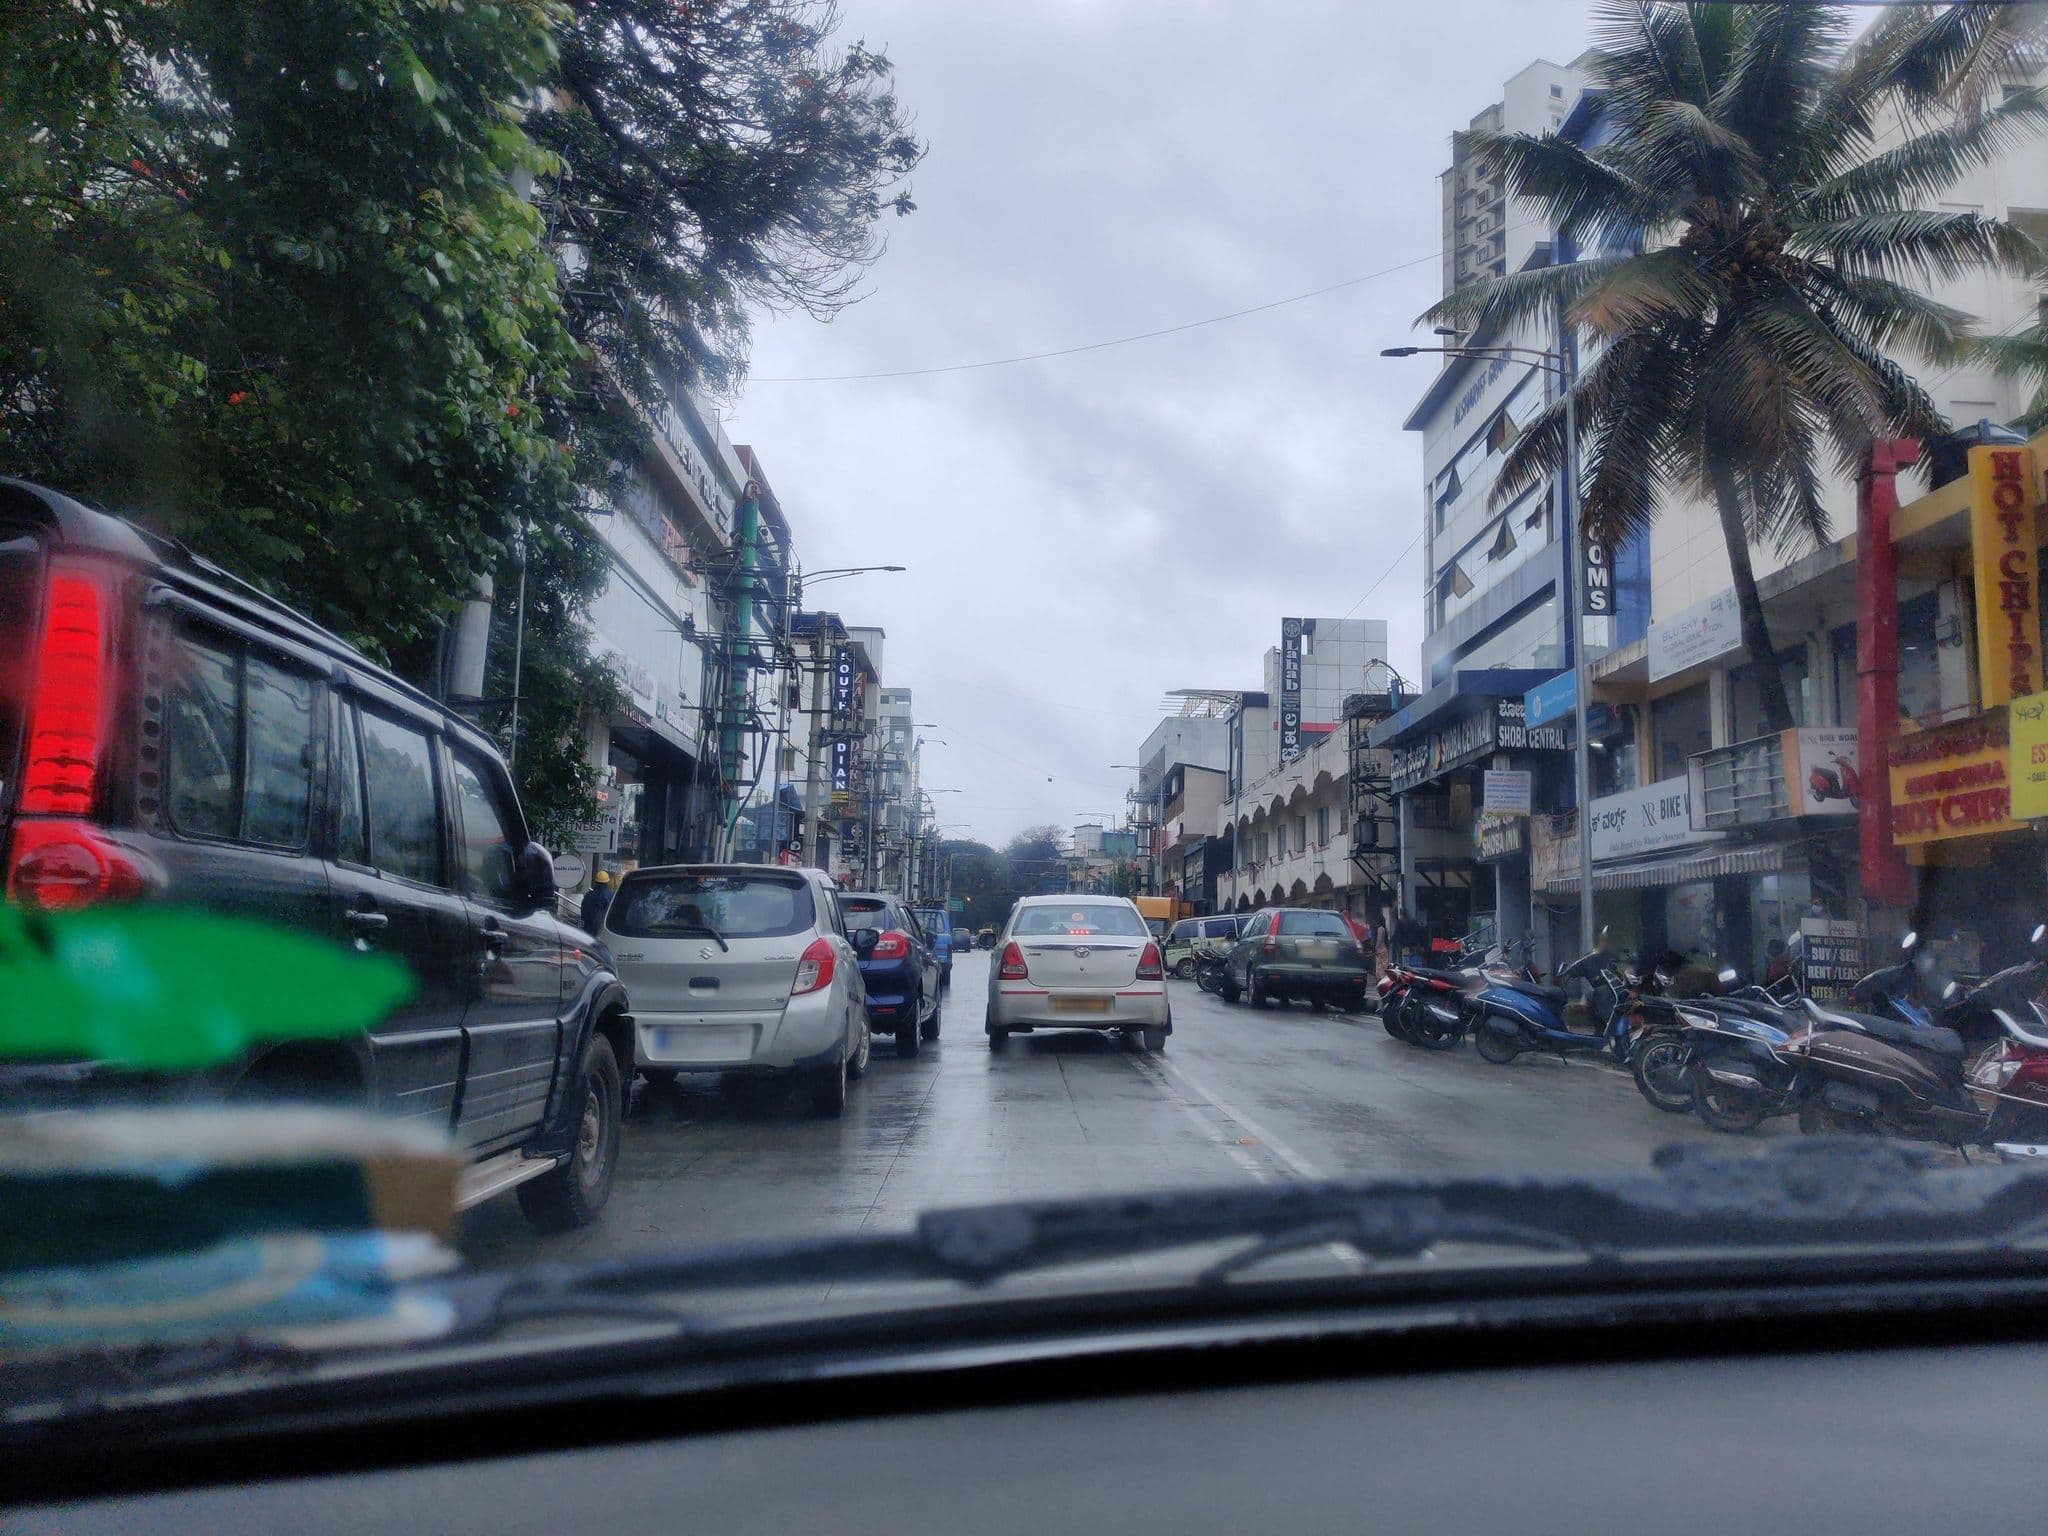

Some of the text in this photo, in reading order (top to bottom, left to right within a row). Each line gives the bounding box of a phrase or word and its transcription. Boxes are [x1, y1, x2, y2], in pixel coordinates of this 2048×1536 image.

[1991, 451, 2024, 544] HOT
[1286, 640, 1299, 691] Lahab
[1499, 725, 1566, 750] SHOBA CENTRAL
[2032, 744, 2048, 765] ES
[1660, 795, 1681, 820] BIKE
[1812, 946, 1831, 961] BUY
[1807, 965, 1831, 979] RENT
[1811, 986, 1834, 999] SITES
